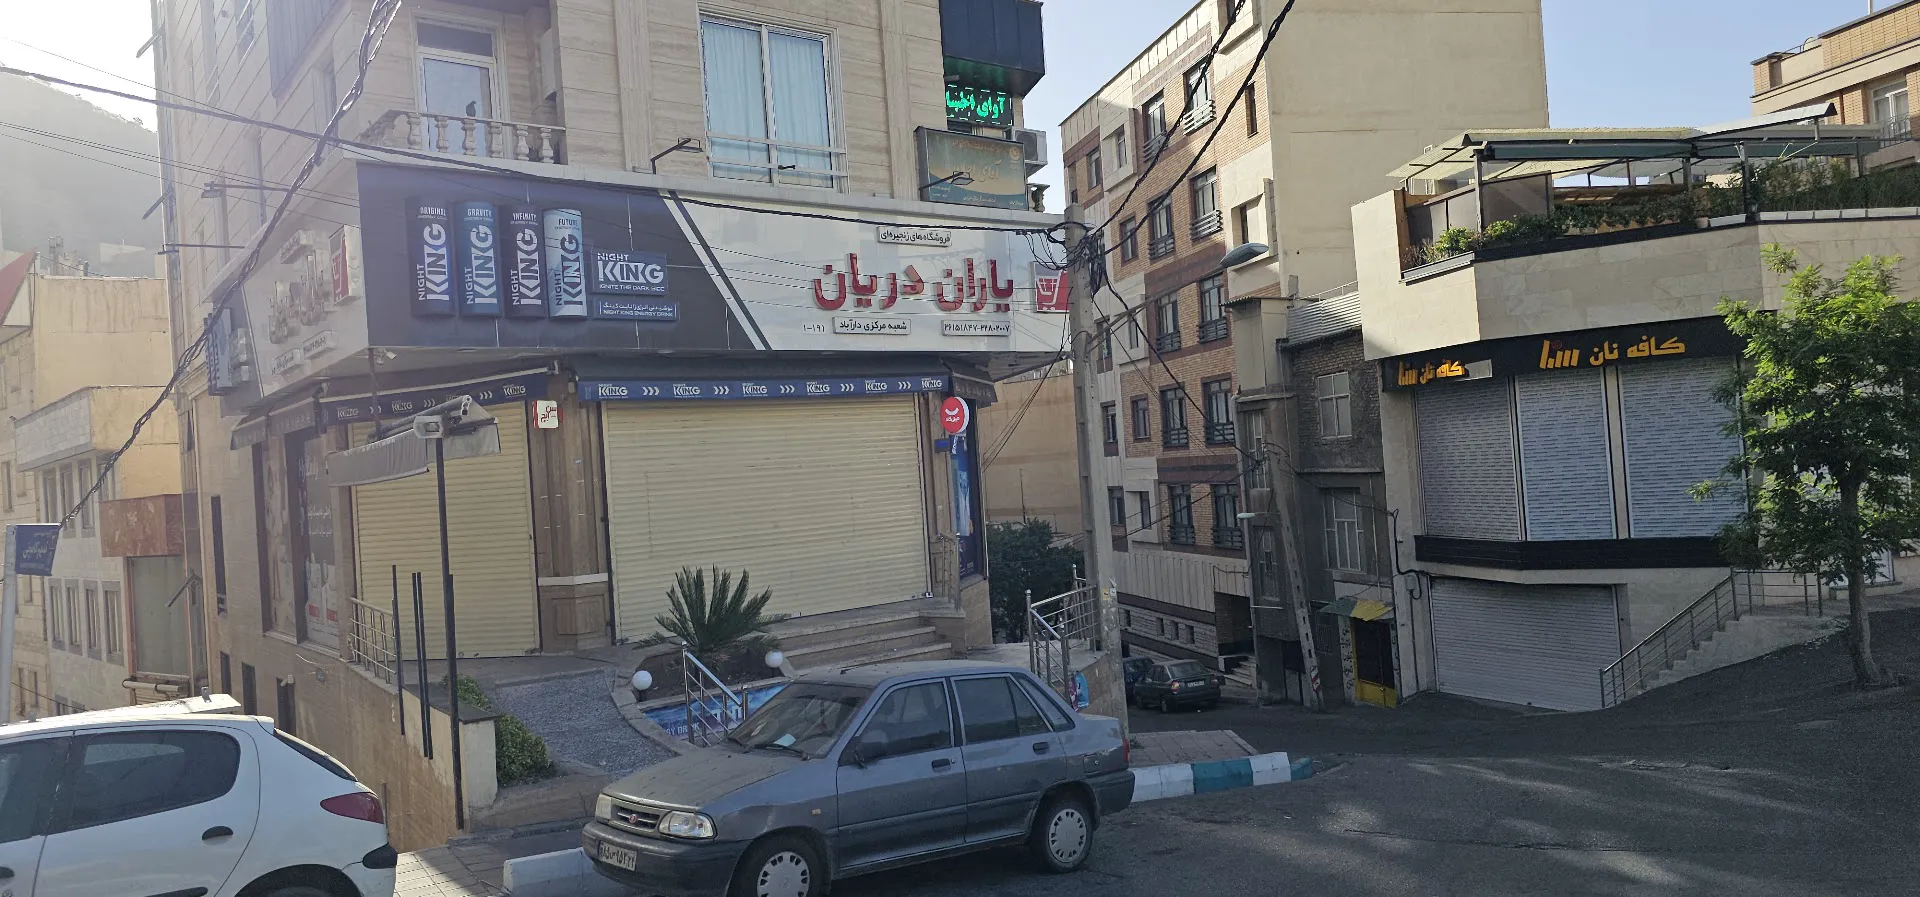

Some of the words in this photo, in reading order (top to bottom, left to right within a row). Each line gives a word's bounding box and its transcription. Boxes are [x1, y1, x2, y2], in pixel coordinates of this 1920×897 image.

[420, 206, 446, 216] ORIGINAL
[467, 208, 492, 217] GRAVITY
[513, 212, 537, 221] INFINITY
[424, 223, 449, 300] KING
[470, 224, 498, 304] KING
[597, 252, 629, 261] NIGHT
[516, 228, 542, 305] KING
[560, 233, 583, 305] KING
[598, 260, 664, 284] KING
[417, 264, 425, 300] NIGHT
[465, 267, 474, 304] NIGHT
[511, 269, 520, 305] NIGHT
[813, 252, 924, 310] دریان
[937, 258, 1013, 312] یاران
[839, 318, 862, 331] دارآباد
[864, 320, 886, 332] مرکزی
[888, 321, 907, 332] شعبه
[1590, 341, 1619, 366] نان
[1627, 335, 1686, 358] کافه
[1420, 362, 1434, 385] نان
[1436, 360, 1465, 378] کافه
[598, 387, 628, 396] KING
[674, 387, 700, 395] KING
[743, 386, 767, 394] KING
[807, 384, 830, 392] KING
[865, 382, 887, 391] KING
[922, 380, 942, 389] KING
